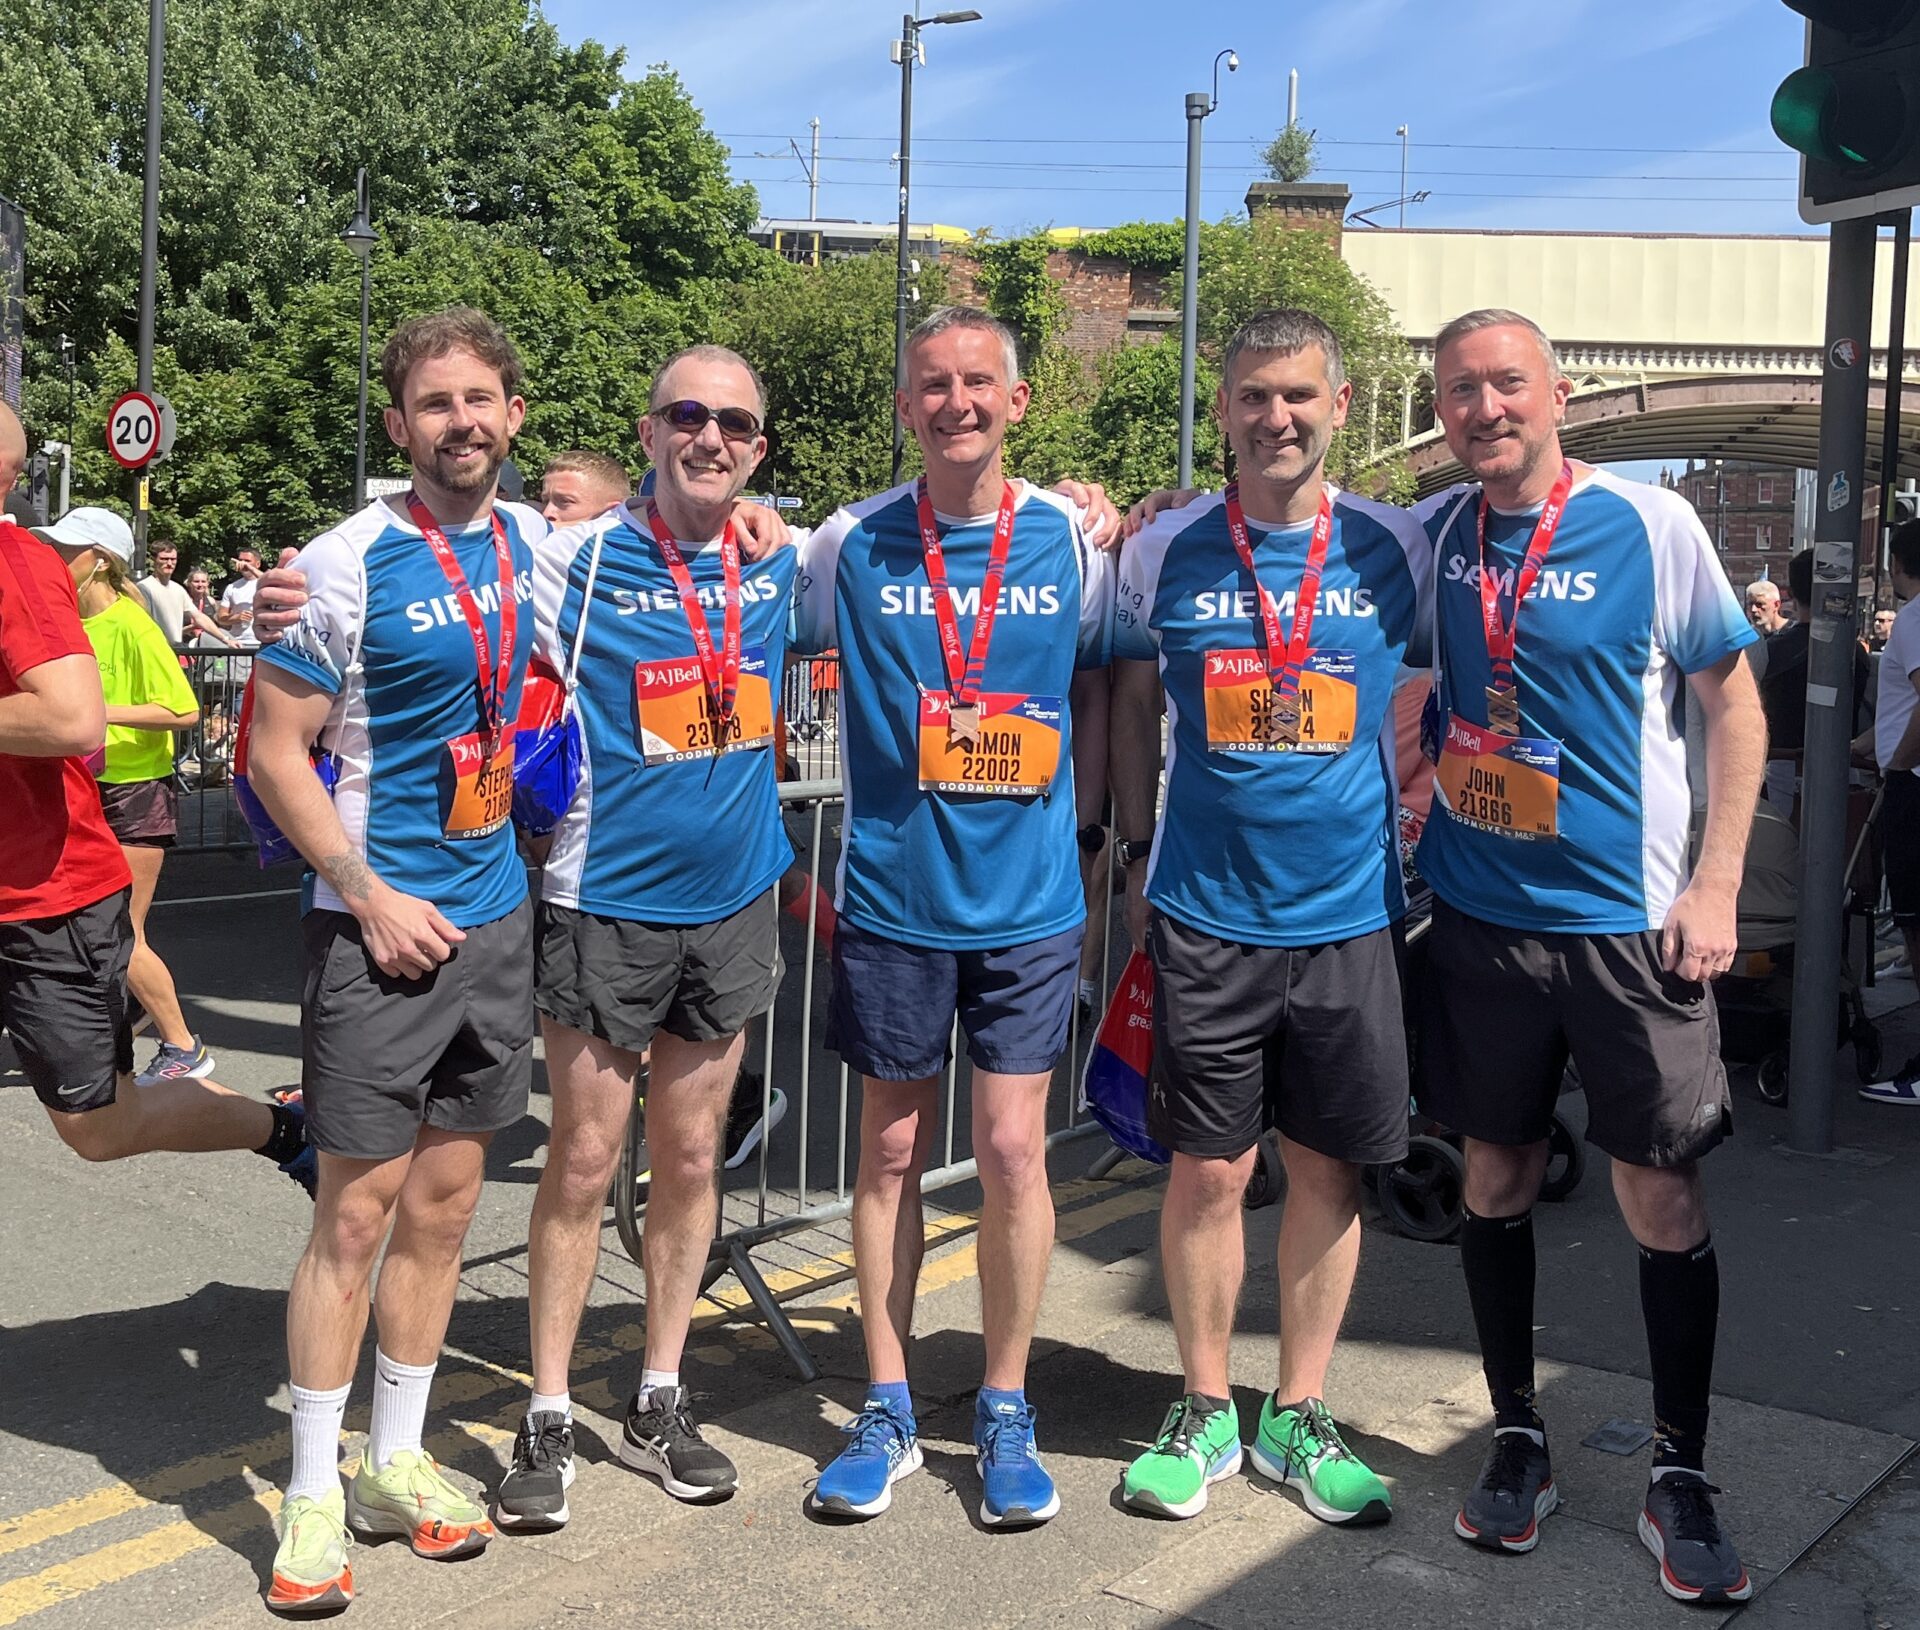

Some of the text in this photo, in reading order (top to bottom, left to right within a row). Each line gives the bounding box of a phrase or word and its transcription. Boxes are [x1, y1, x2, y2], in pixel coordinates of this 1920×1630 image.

[116, 415, 152, 445] 20
[371, 480, 406, 489] CASTLE
[1231, 523, 1246, 546] 2023
[406, 570, 533, 633] SIEMNS
[880, 584, 1059, 615] SIEMENS
[1194, 588, 1374, 621] SIEMENS
[502, 630, 513, 660] AJBell
[655, 664, 703, 687] AJBell
[1223, 658, 1272, 677] AJBell
[1249, 689, 1313, 713] SHN
[1251, 715, 1315, 740] 234
[1228, 742, 1303, 751] GOODMOVE
[1318, 742, 1337, 751] M&S
[1454, 730, 1481, 752] AJBell
[962, 756, 1020, 782] 22002
[938, 782, 1009, 793] GOODMOVE
[1021, 785, 1038, 794] M&S
[1465, 766, 1505, 799] JOHN
[1459, 790, 1512, 826] 21866
[1446, 810, 1501, 835] GOODMOVE
[1514, 831, 1536, 841] M&S
[1536, 822, 1550, 833] HM
